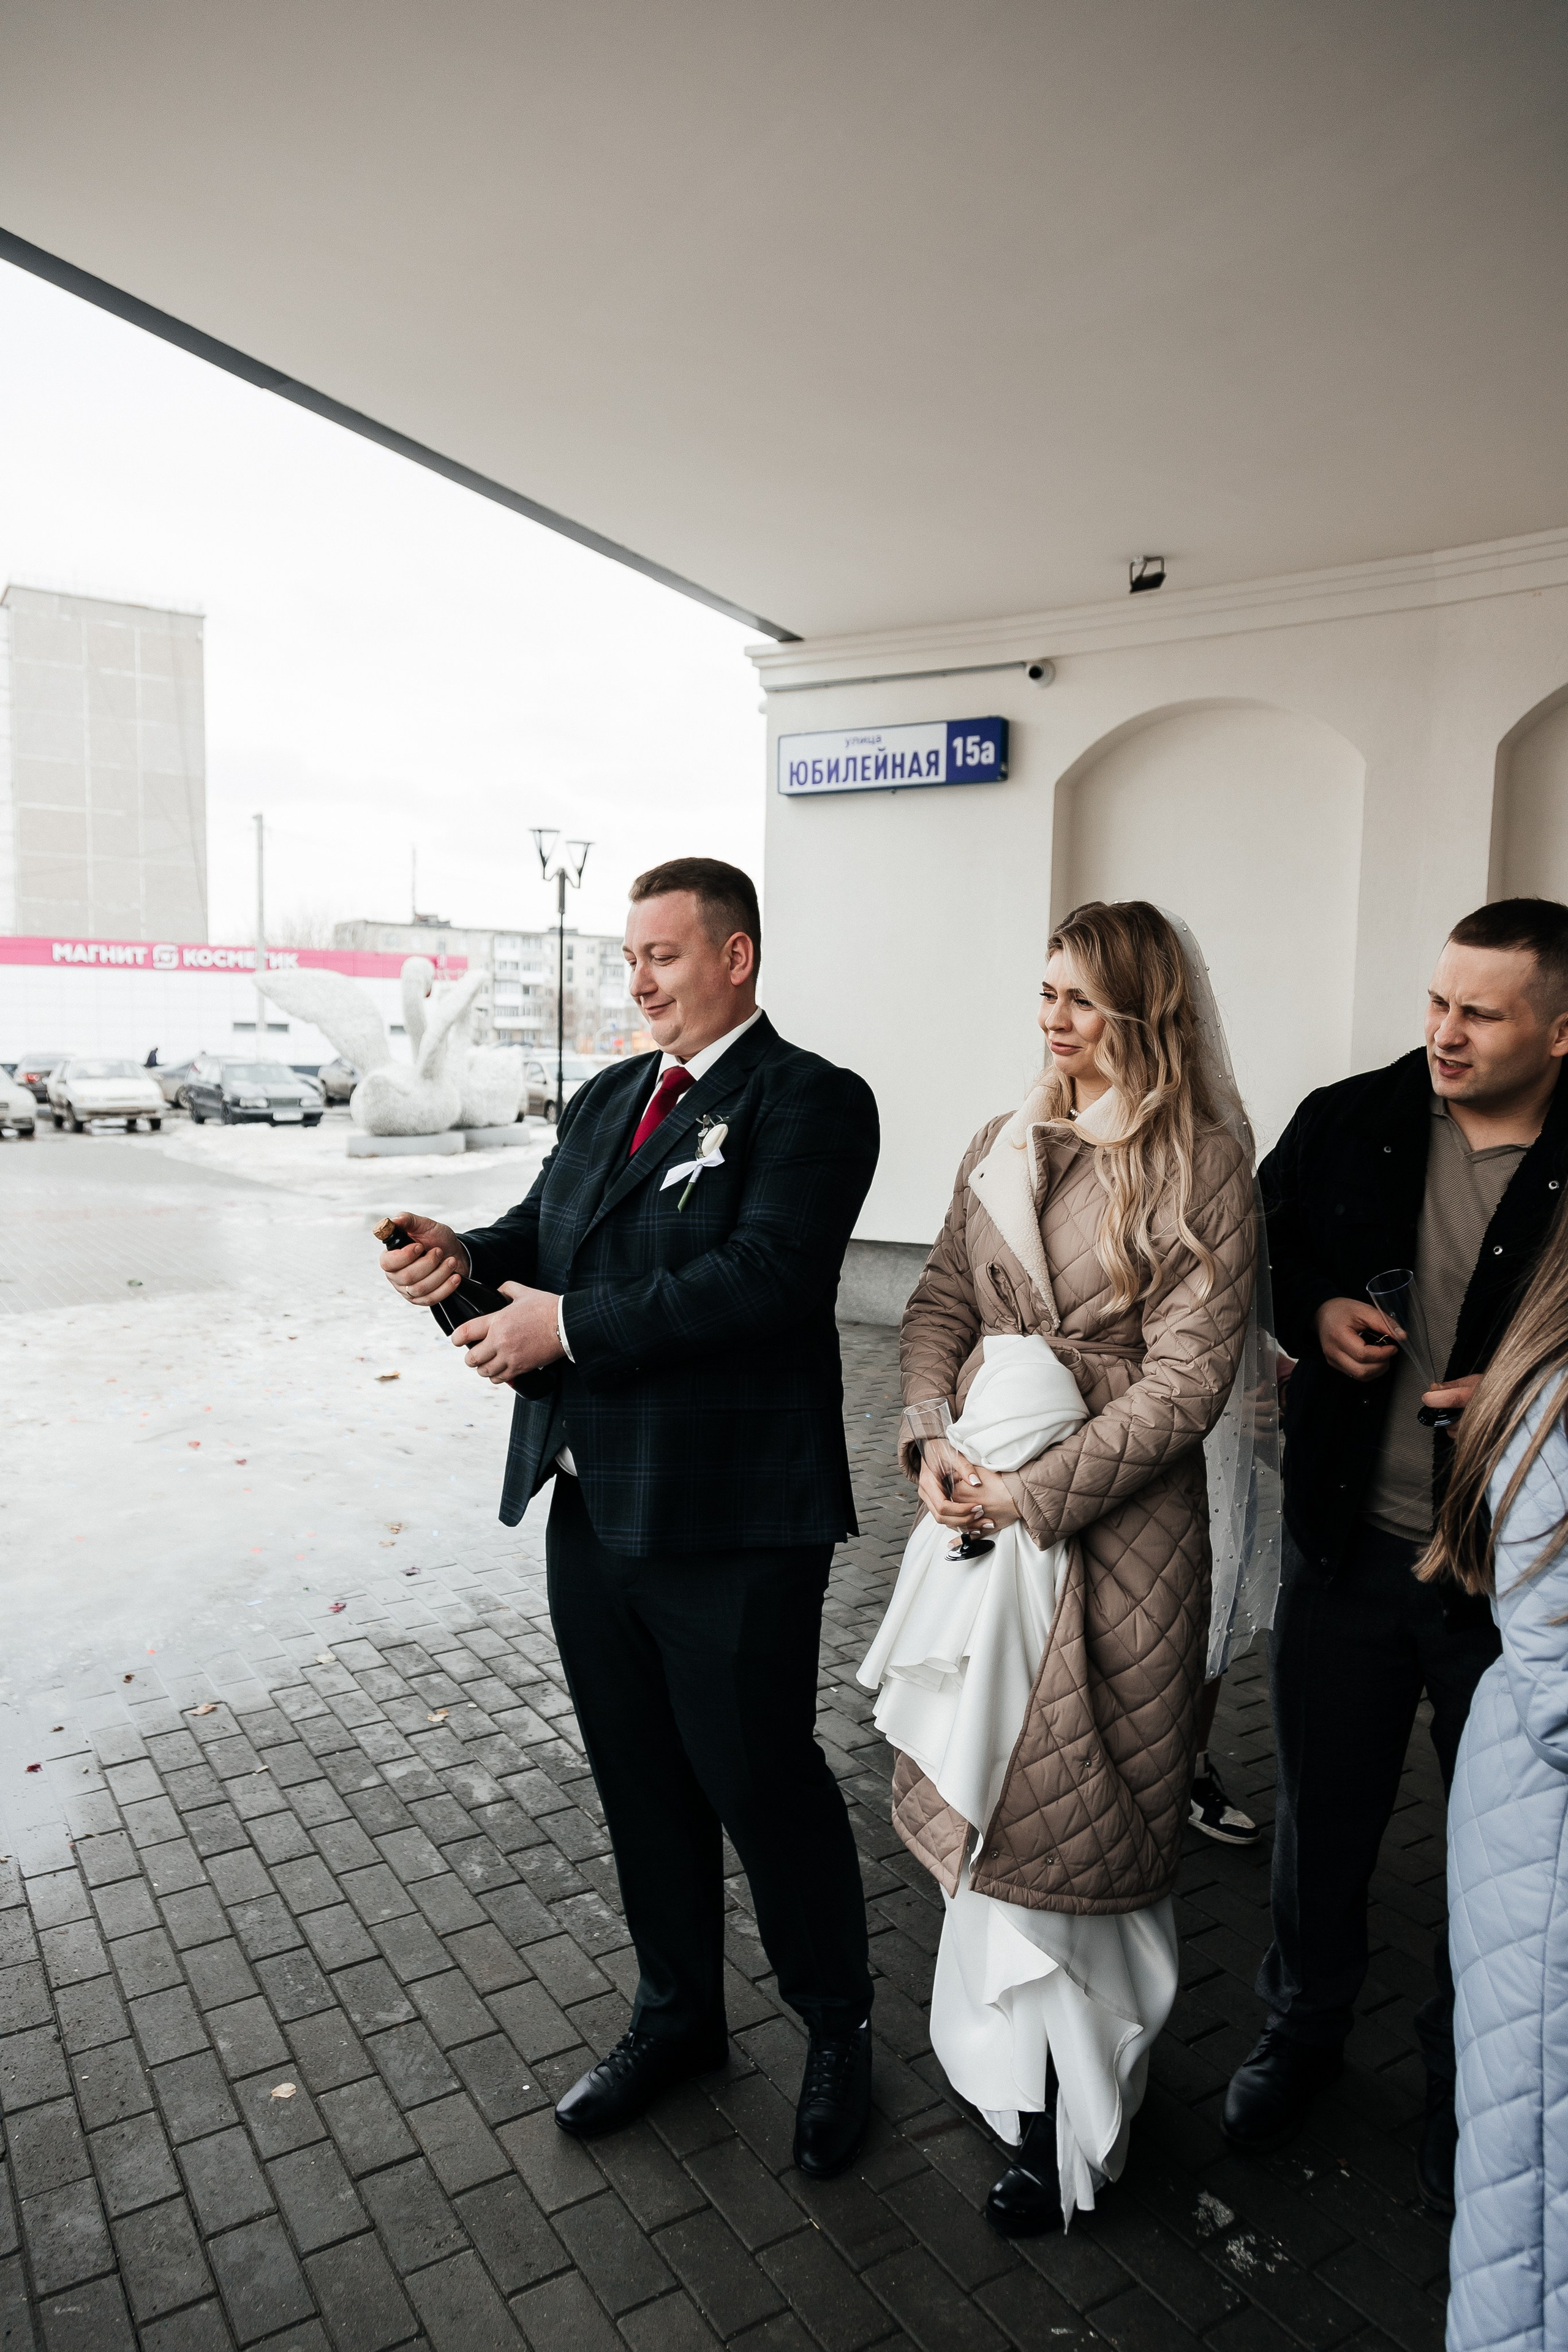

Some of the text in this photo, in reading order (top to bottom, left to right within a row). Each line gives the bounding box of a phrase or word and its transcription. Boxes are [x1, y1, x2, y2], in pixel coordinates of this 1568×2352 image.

[845, 734, 882, 748] улица
[790, 735, 995, 786] ЮБИЛЕЙНАЯ 15а
[52, 943, 299, 969] МАГНИТ КОСМЕИК
